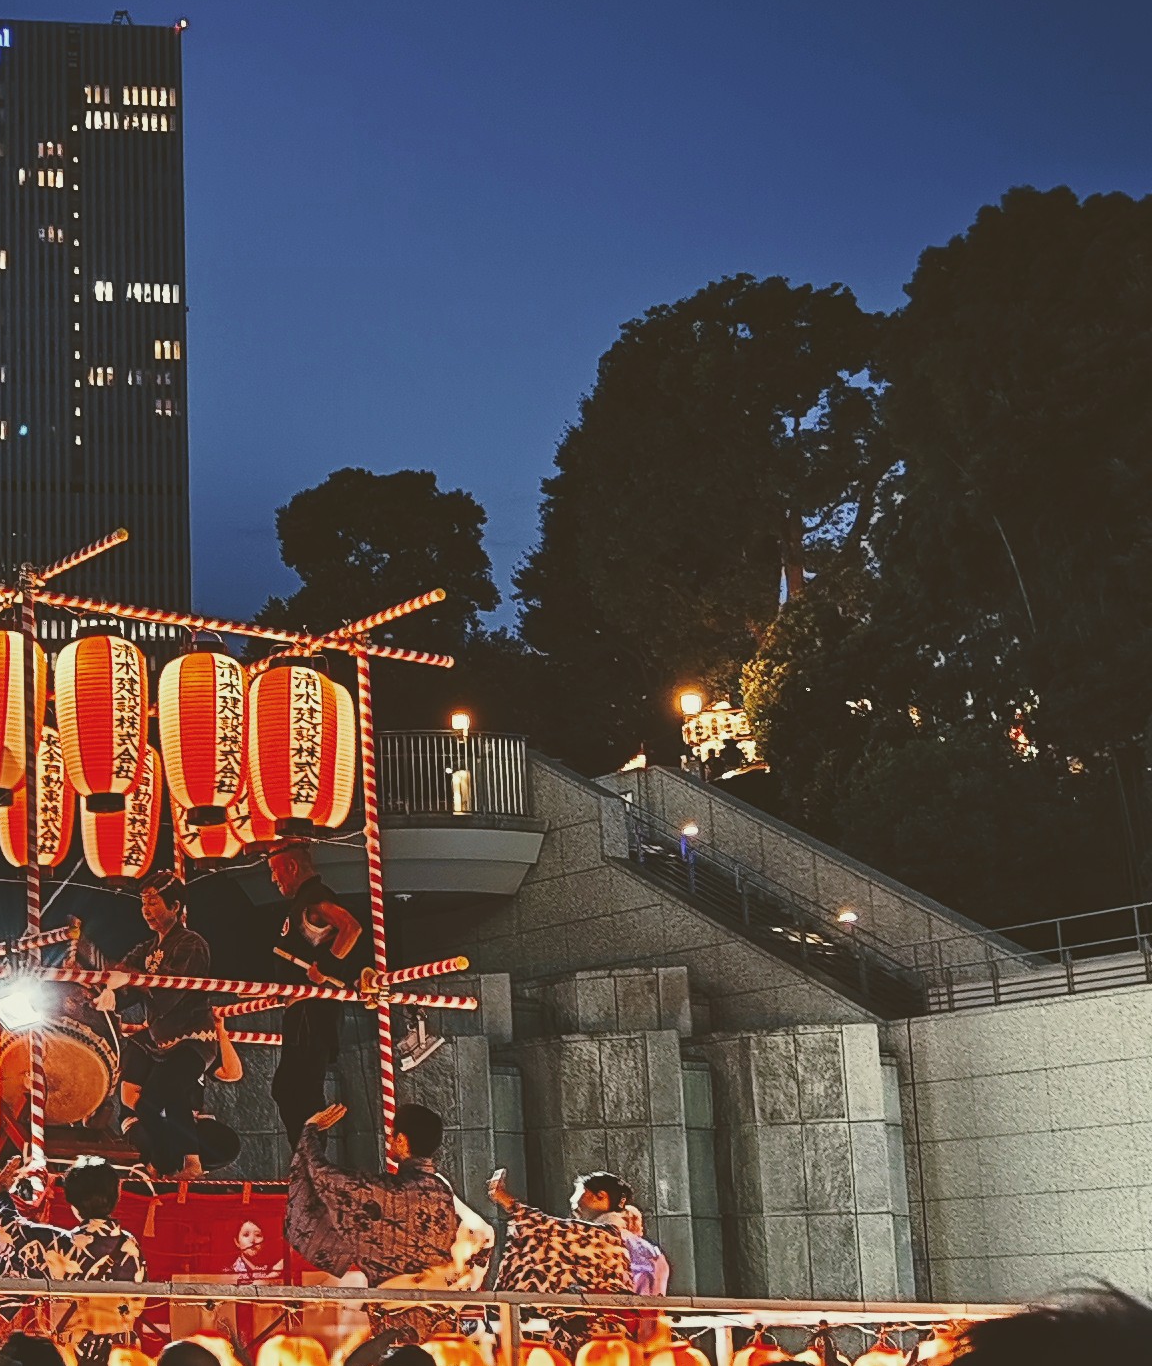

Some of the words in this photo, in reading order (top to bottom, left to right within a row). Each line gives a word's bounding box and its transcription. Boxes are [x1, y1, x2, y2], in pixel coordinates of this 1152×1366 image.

[112, 643, 141, 780] 清水建設株式会社
[215, 660, 243, 794] 清水建設株式会社
[291, 671, 323, 804] 清水建設株式会社
[36, 733, 64, 855] 安全自動車株式会社
